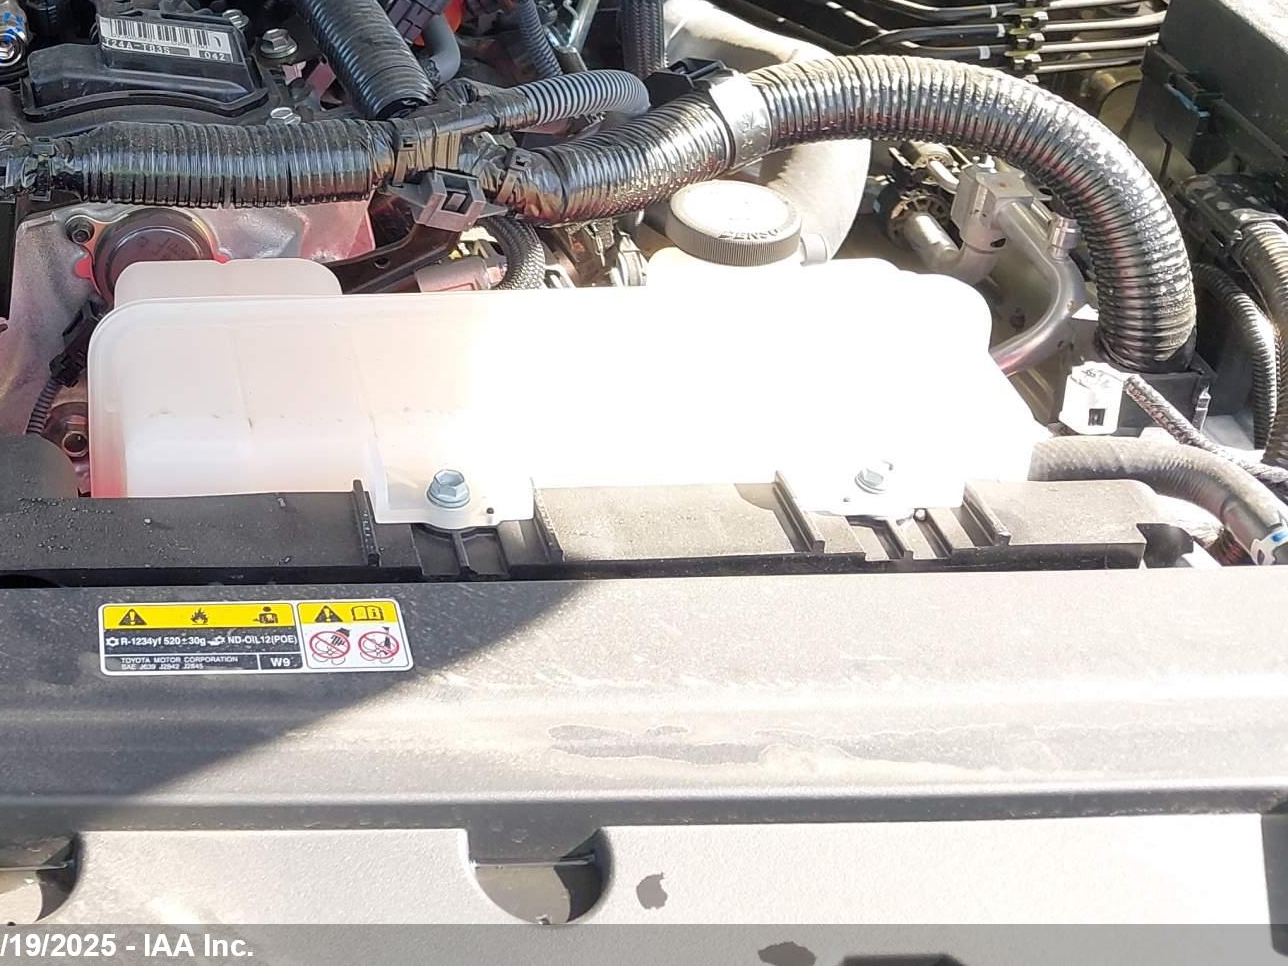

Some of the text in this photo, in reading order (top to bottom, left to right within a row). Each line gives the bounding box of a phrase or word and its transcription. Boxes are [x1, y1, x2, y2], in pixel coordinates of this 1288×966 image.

[120, 636, 162, 647] R-1234yf
[228, 635, 298, 645] ND-OIL12(POE)
[270, 657, 291, 667] W9
